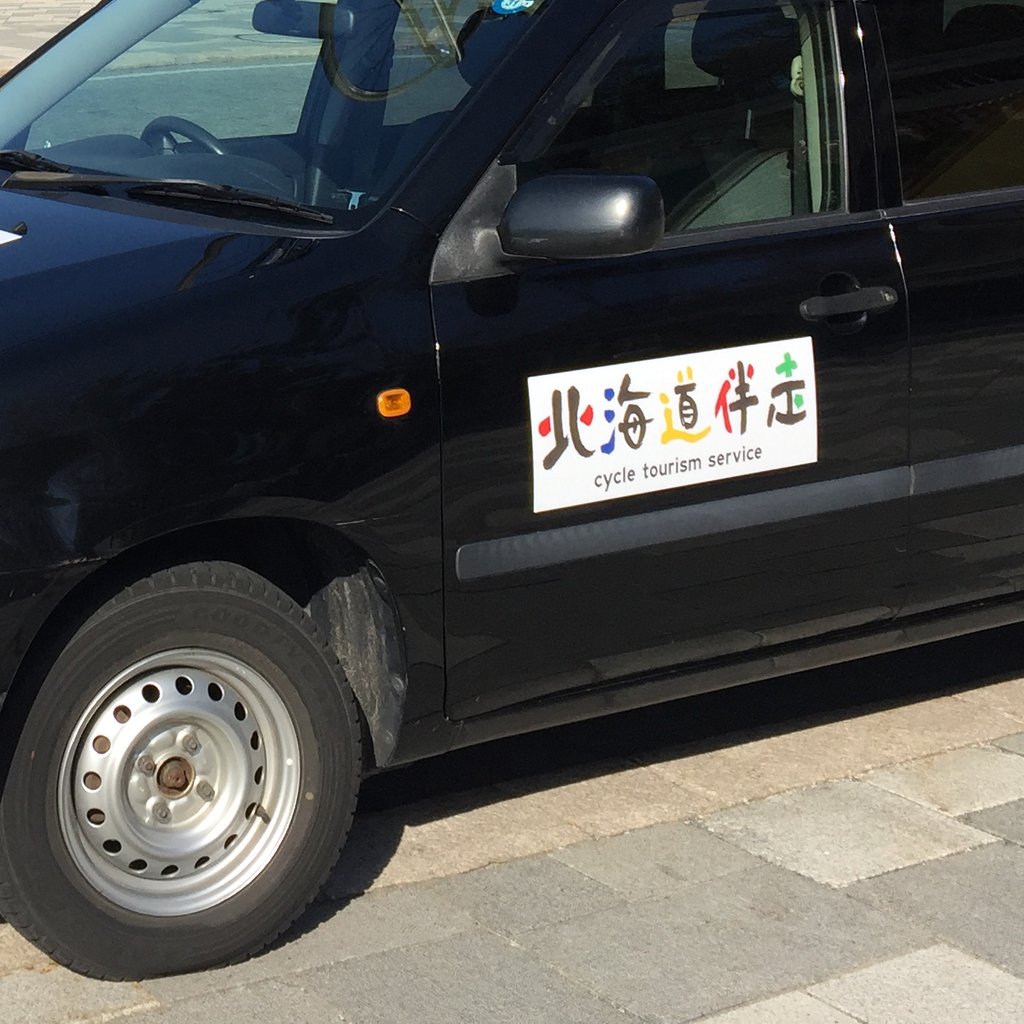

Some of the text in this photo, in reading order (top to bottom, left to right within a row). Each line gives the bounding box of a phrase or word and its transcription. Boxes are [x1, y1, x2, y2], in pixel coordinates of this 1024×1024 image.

[594, 445, 763, 492] cycle tourism service
